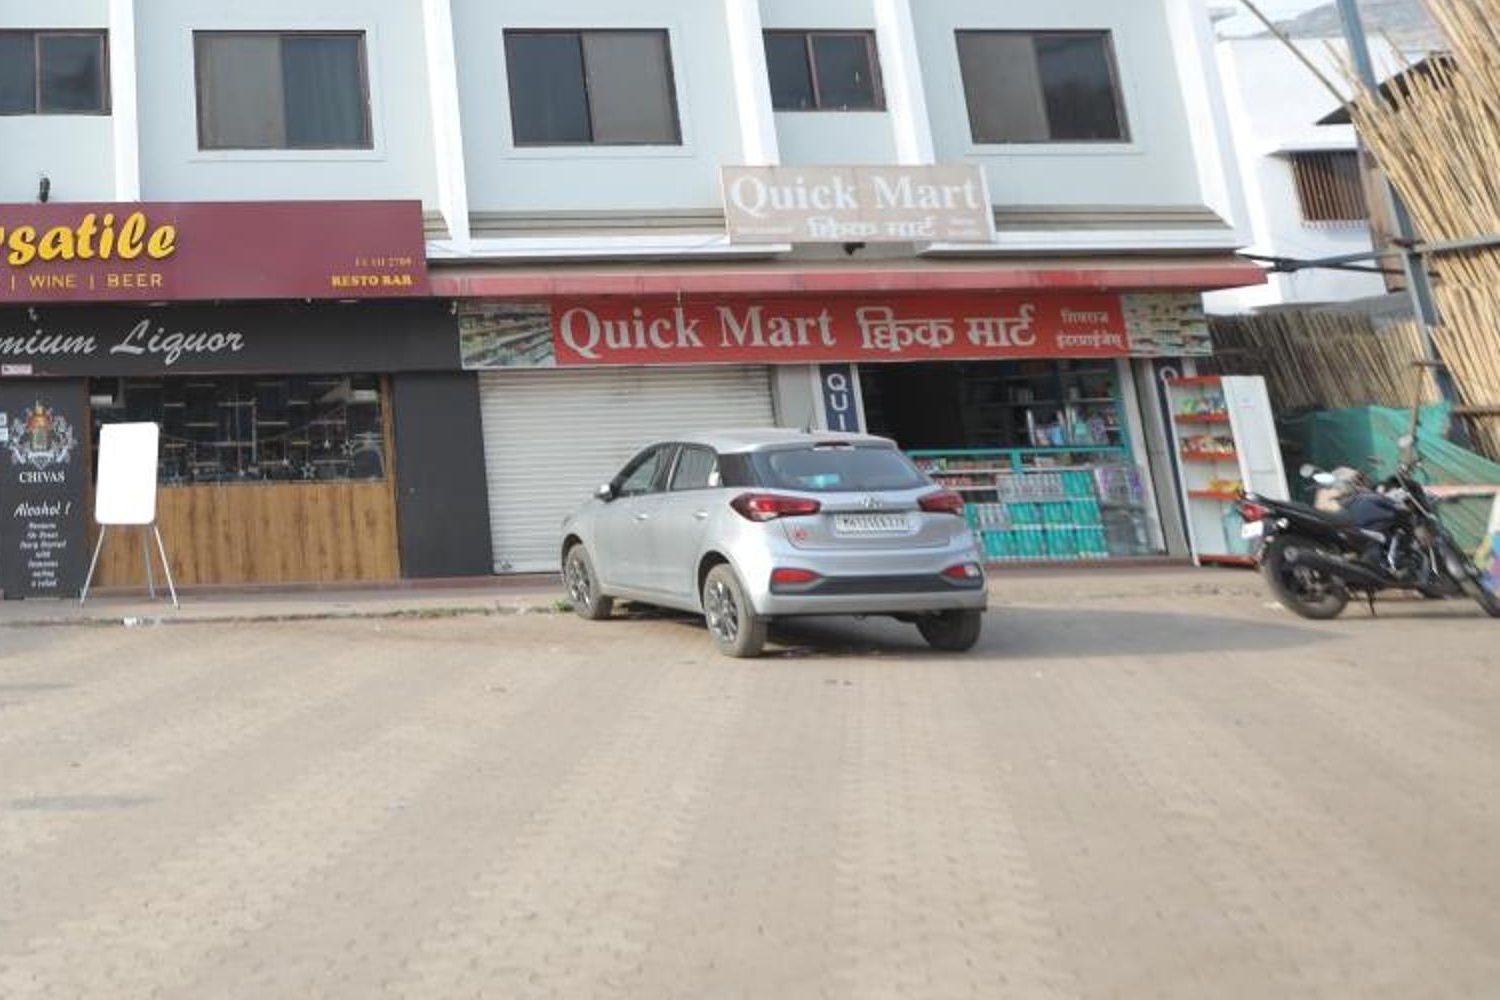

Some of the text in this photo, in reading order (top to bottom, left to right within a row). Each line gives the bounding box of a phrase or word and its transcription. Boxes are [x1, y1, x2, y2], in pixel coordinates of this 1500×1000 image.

[730, 174, 982, 218] Quick Mart
[29, 274, 77, 289] WINE
[107, 273, 163, 288] BEER
[331, 274, 412, 287] RESTO BAR
[110, 318, 245, 366] Liquor
[560, 305, 837, 359] Quick Mart
[964, 303, 1036, 347] मार्ट
[827, 372, 848, 431] QUI
[19, 471, 66, 484] CHIVAS
[13, 501, 61, 518] Alcohol
